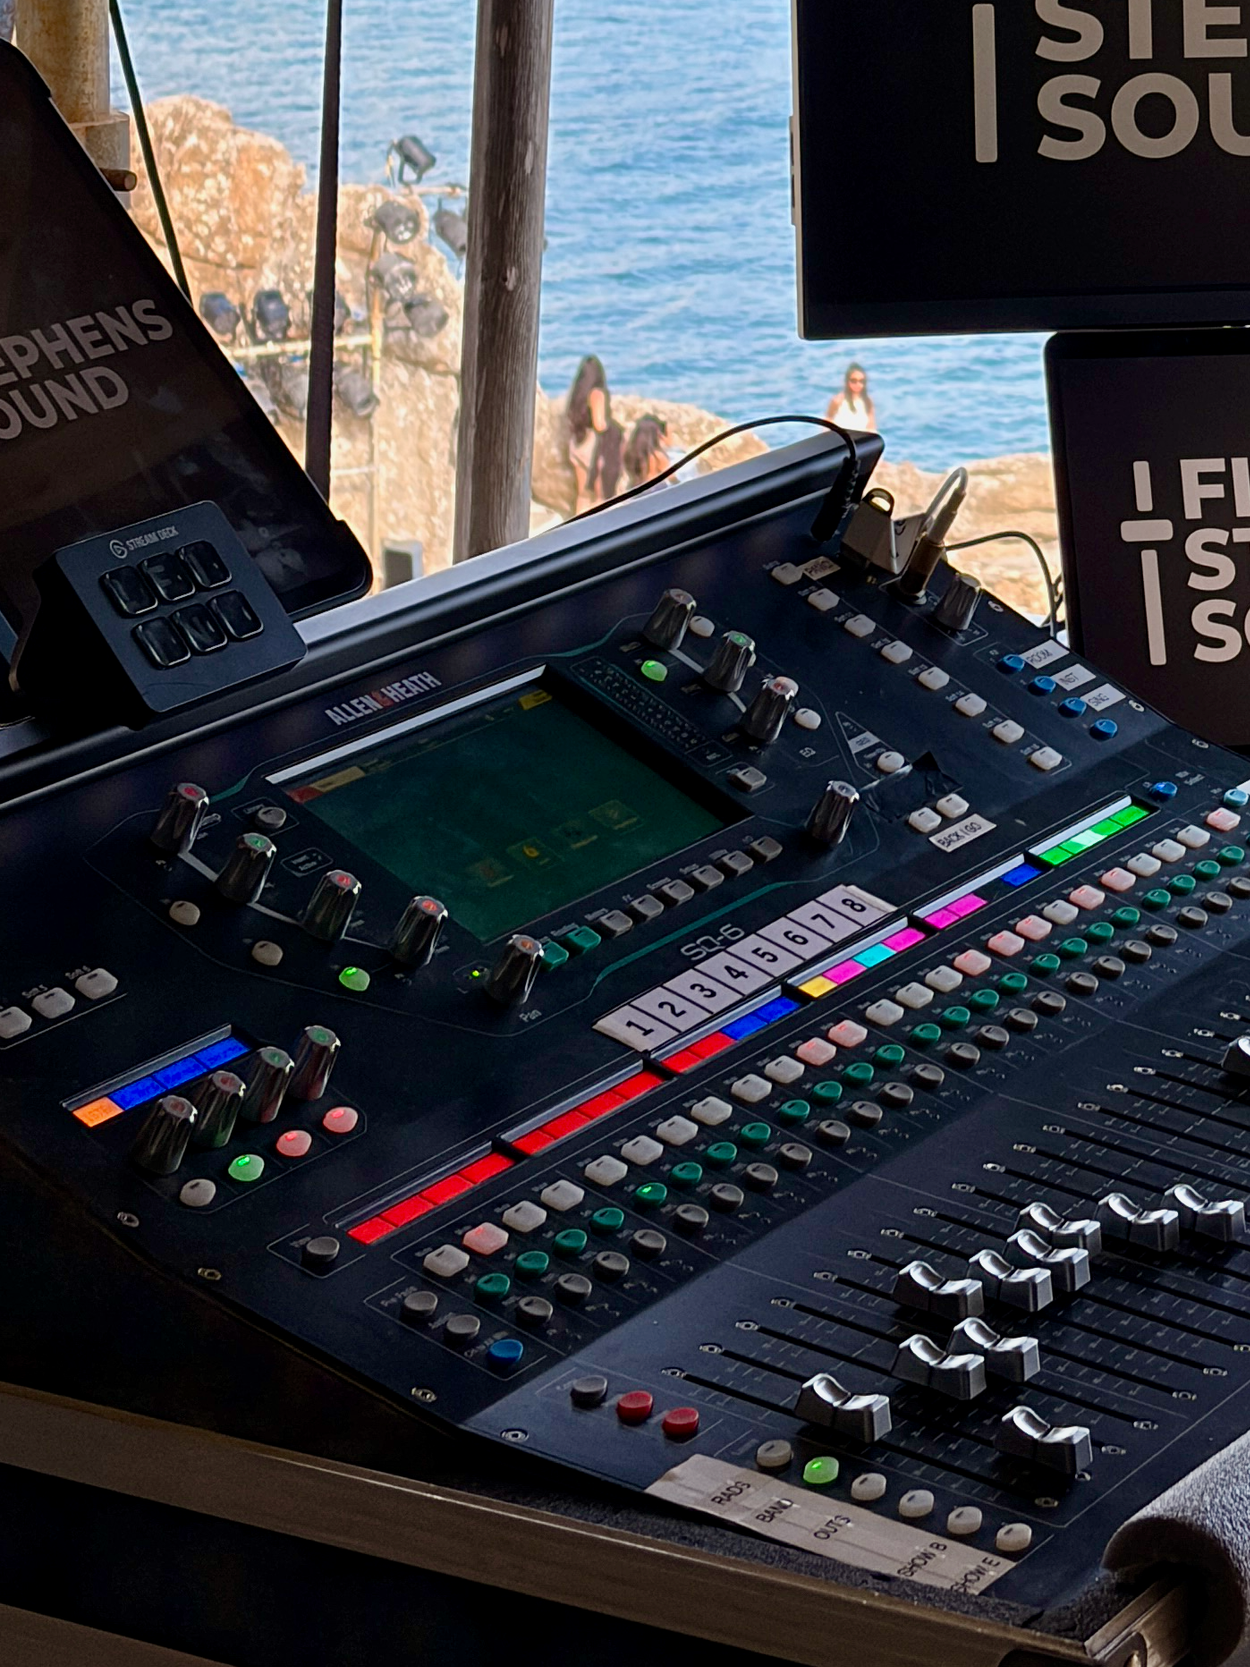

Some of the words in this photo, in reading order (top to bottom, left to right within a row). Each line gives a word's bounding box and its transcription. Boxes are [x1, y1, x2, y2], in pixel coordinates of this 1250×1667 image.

[0, 299, 173, 385] PHENS
[125, 532, 160, 551] STREAM
[157, 525, 180, 540] DECK
[680, 923, 745, 962] SQ-6
[626, 1018, 655, 1037] 1
[658, 1000, 687, 1018] 2
[690, 982, 717, 999] 3
[724, 964, 750, 980] 4
[751, 946, 779, 963] 5
[783, 929, 809, 946] 6
[811, 913, 836, 930] 7
[840, 897, 867, 913] 8
[711, 1480, 751, 1506] RADS
[755, 1498, 794, 1523] BAND
[813, 1515, 852, 1540] OUTS
[897, 1548, 937, 1578] SHOW
[929, 1541, 947, 1552] B
[950, 1564, 989, 1594] SHOW
[981, 1556, 1001, 1568] E
